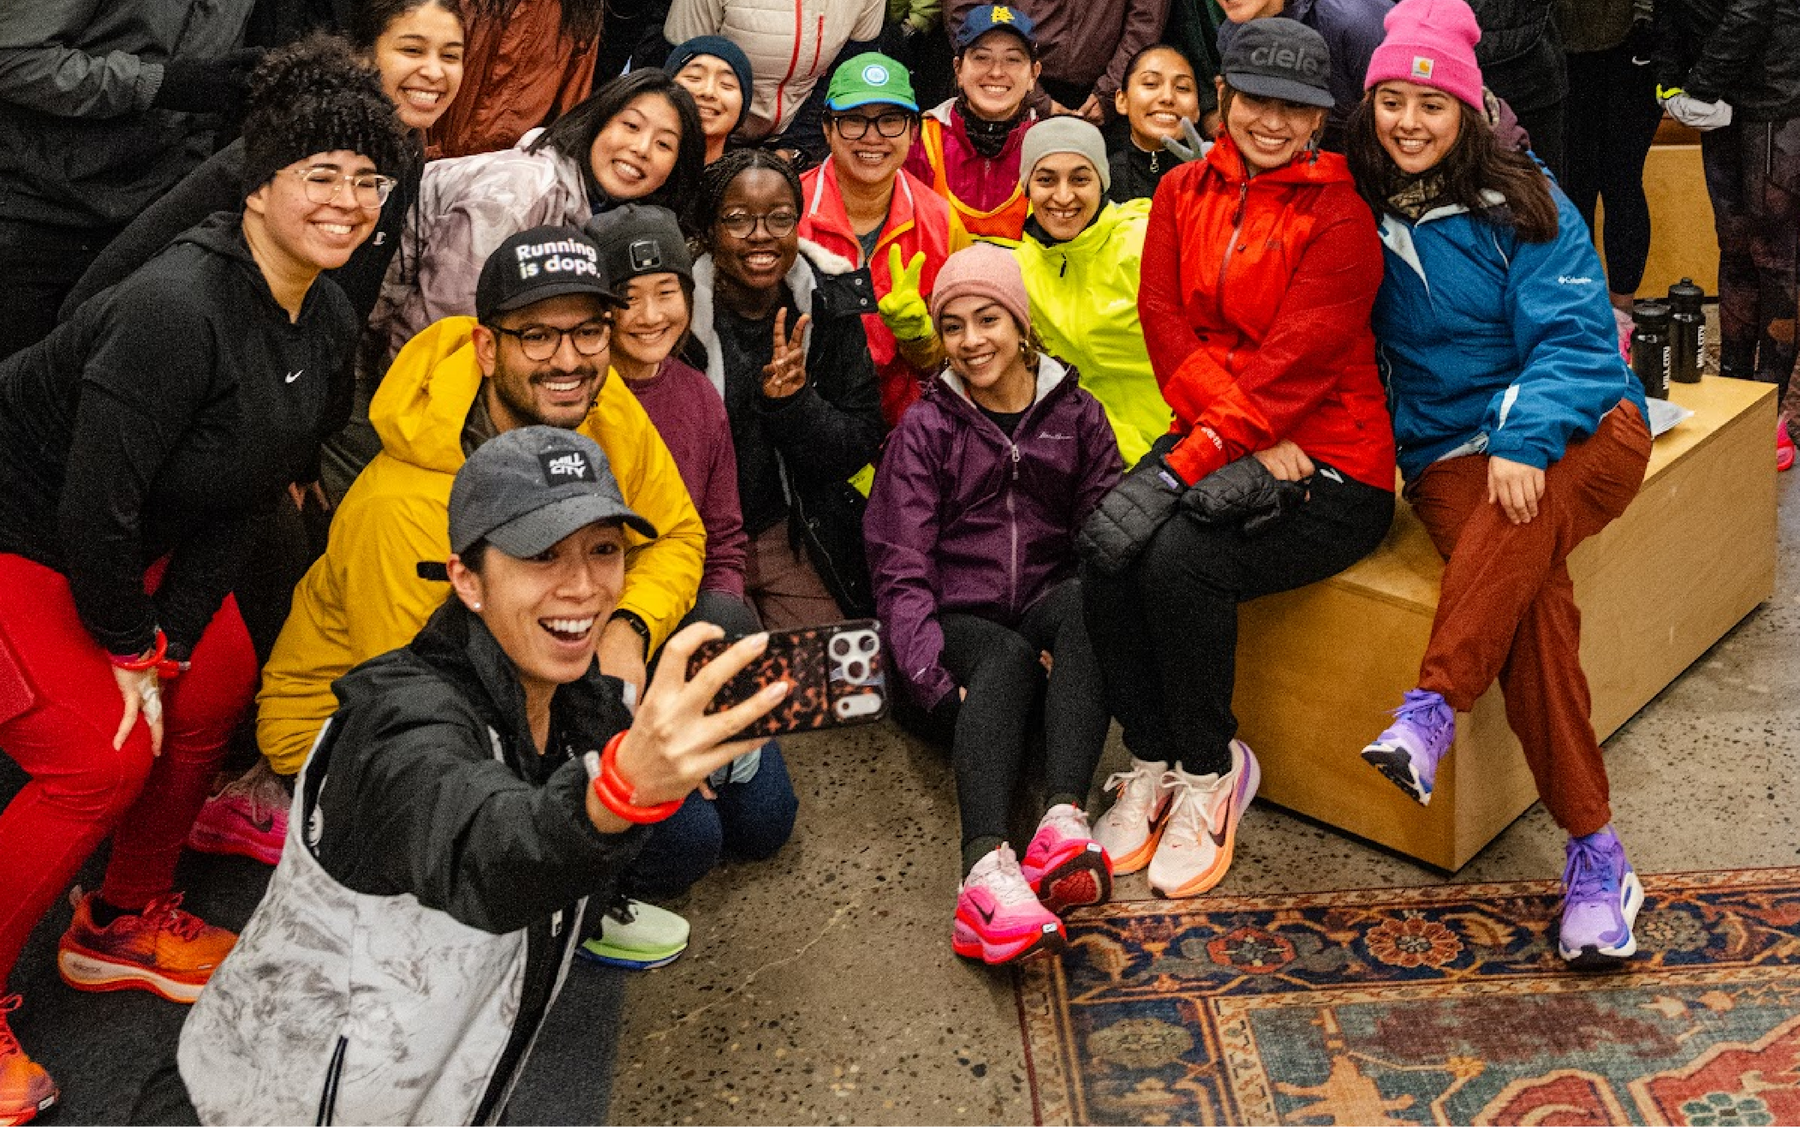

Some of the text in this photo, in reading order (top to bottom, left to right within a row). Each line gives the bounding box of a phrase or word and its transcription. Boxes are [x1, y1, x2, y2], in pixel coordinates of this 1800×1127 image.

[1250, 41, 1320, 73] ciele
[516, 238, 597, 263] Running
[519, 254, 601, 280] is dope.
[549, 452, 584, 468] MILL
[550, 462, 587, 478] CITY
